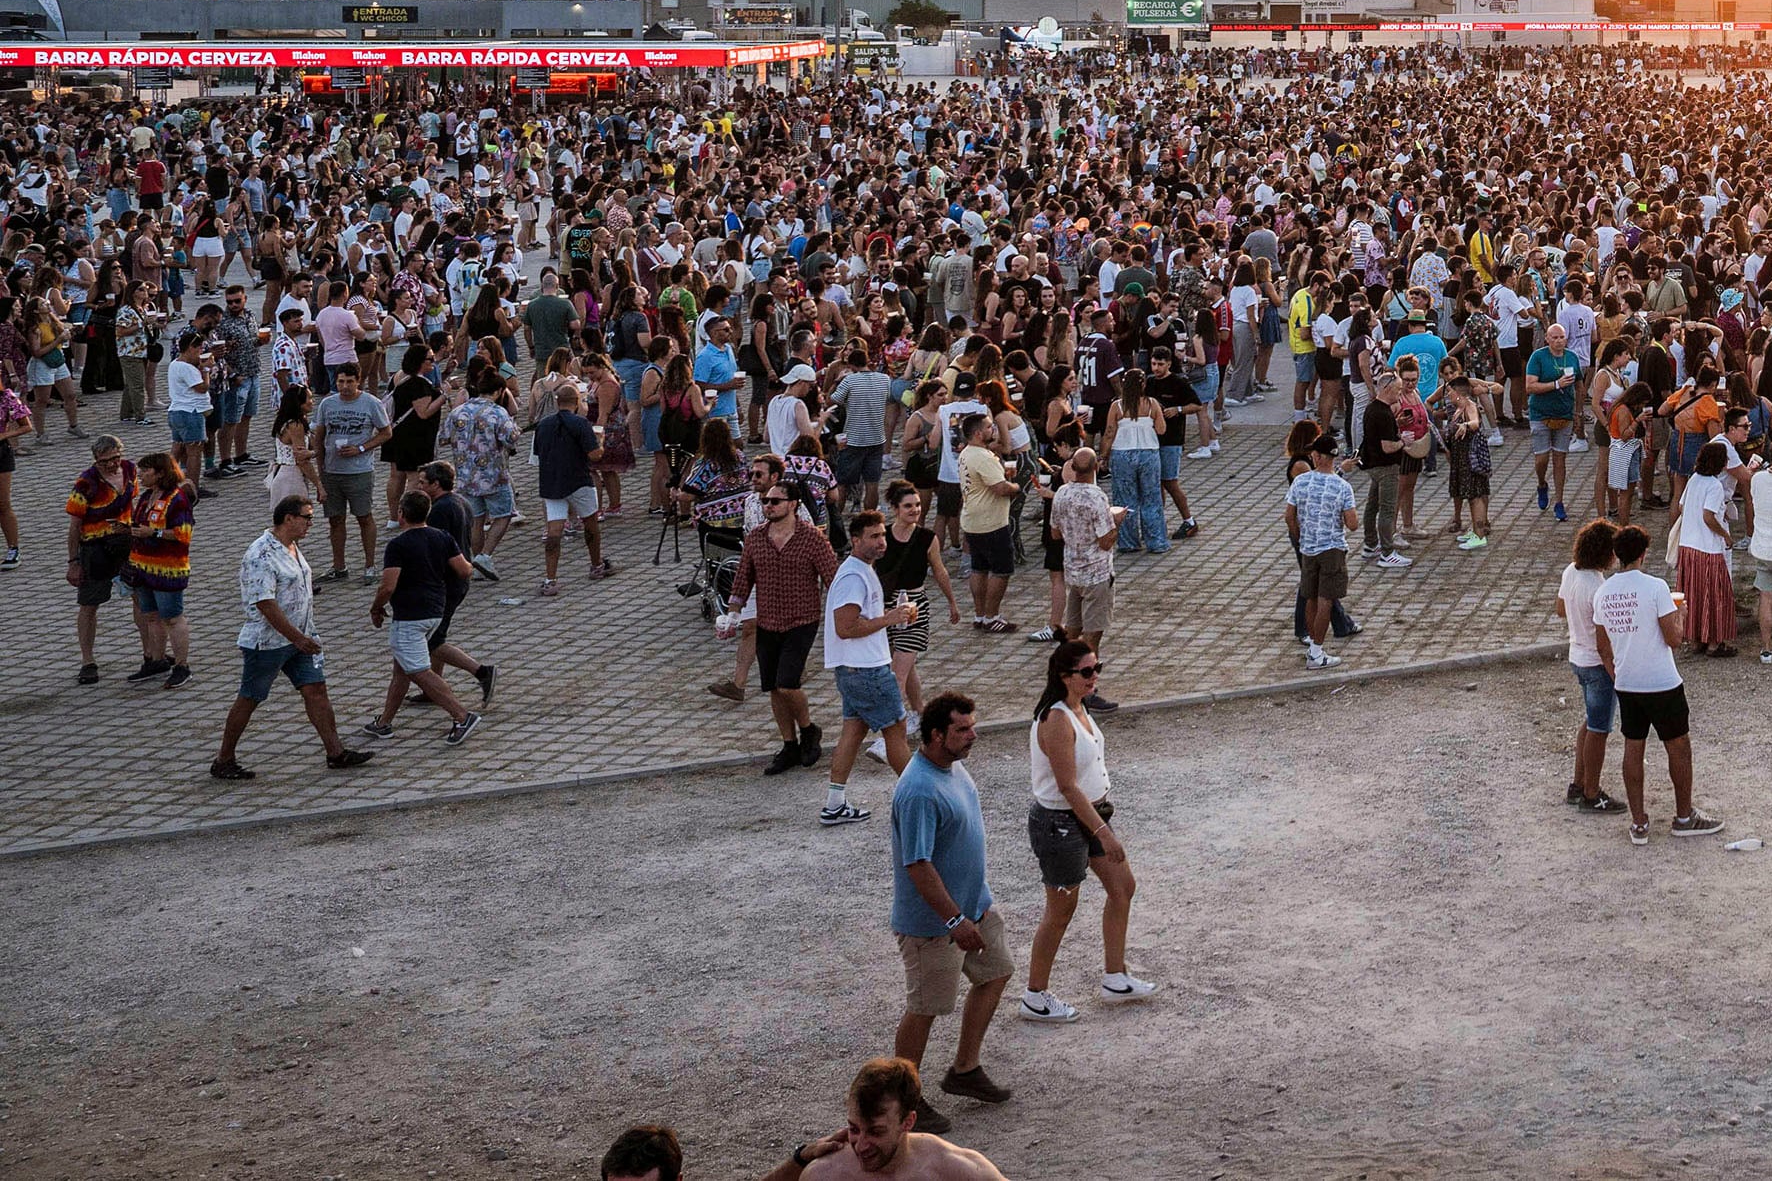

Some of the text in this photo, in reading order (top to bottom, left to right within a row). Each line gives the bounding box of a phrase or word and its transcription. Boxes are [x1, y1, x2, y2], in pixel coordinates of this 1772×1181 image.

[1133, 1, 1177, 9] RECARGA
[1133, 9, 1178, 18] PULSERAS
[35, 48, 276, 64] BARRA RÁPIDA CERVEZA
[292, 51, 326, 60] Mahou
[352, 51, 386, 60] Mahou
[402, 48, 630, 65] BARRA RÁPIDA CERVEZA
[644, 51, 677, 60] Mahou
